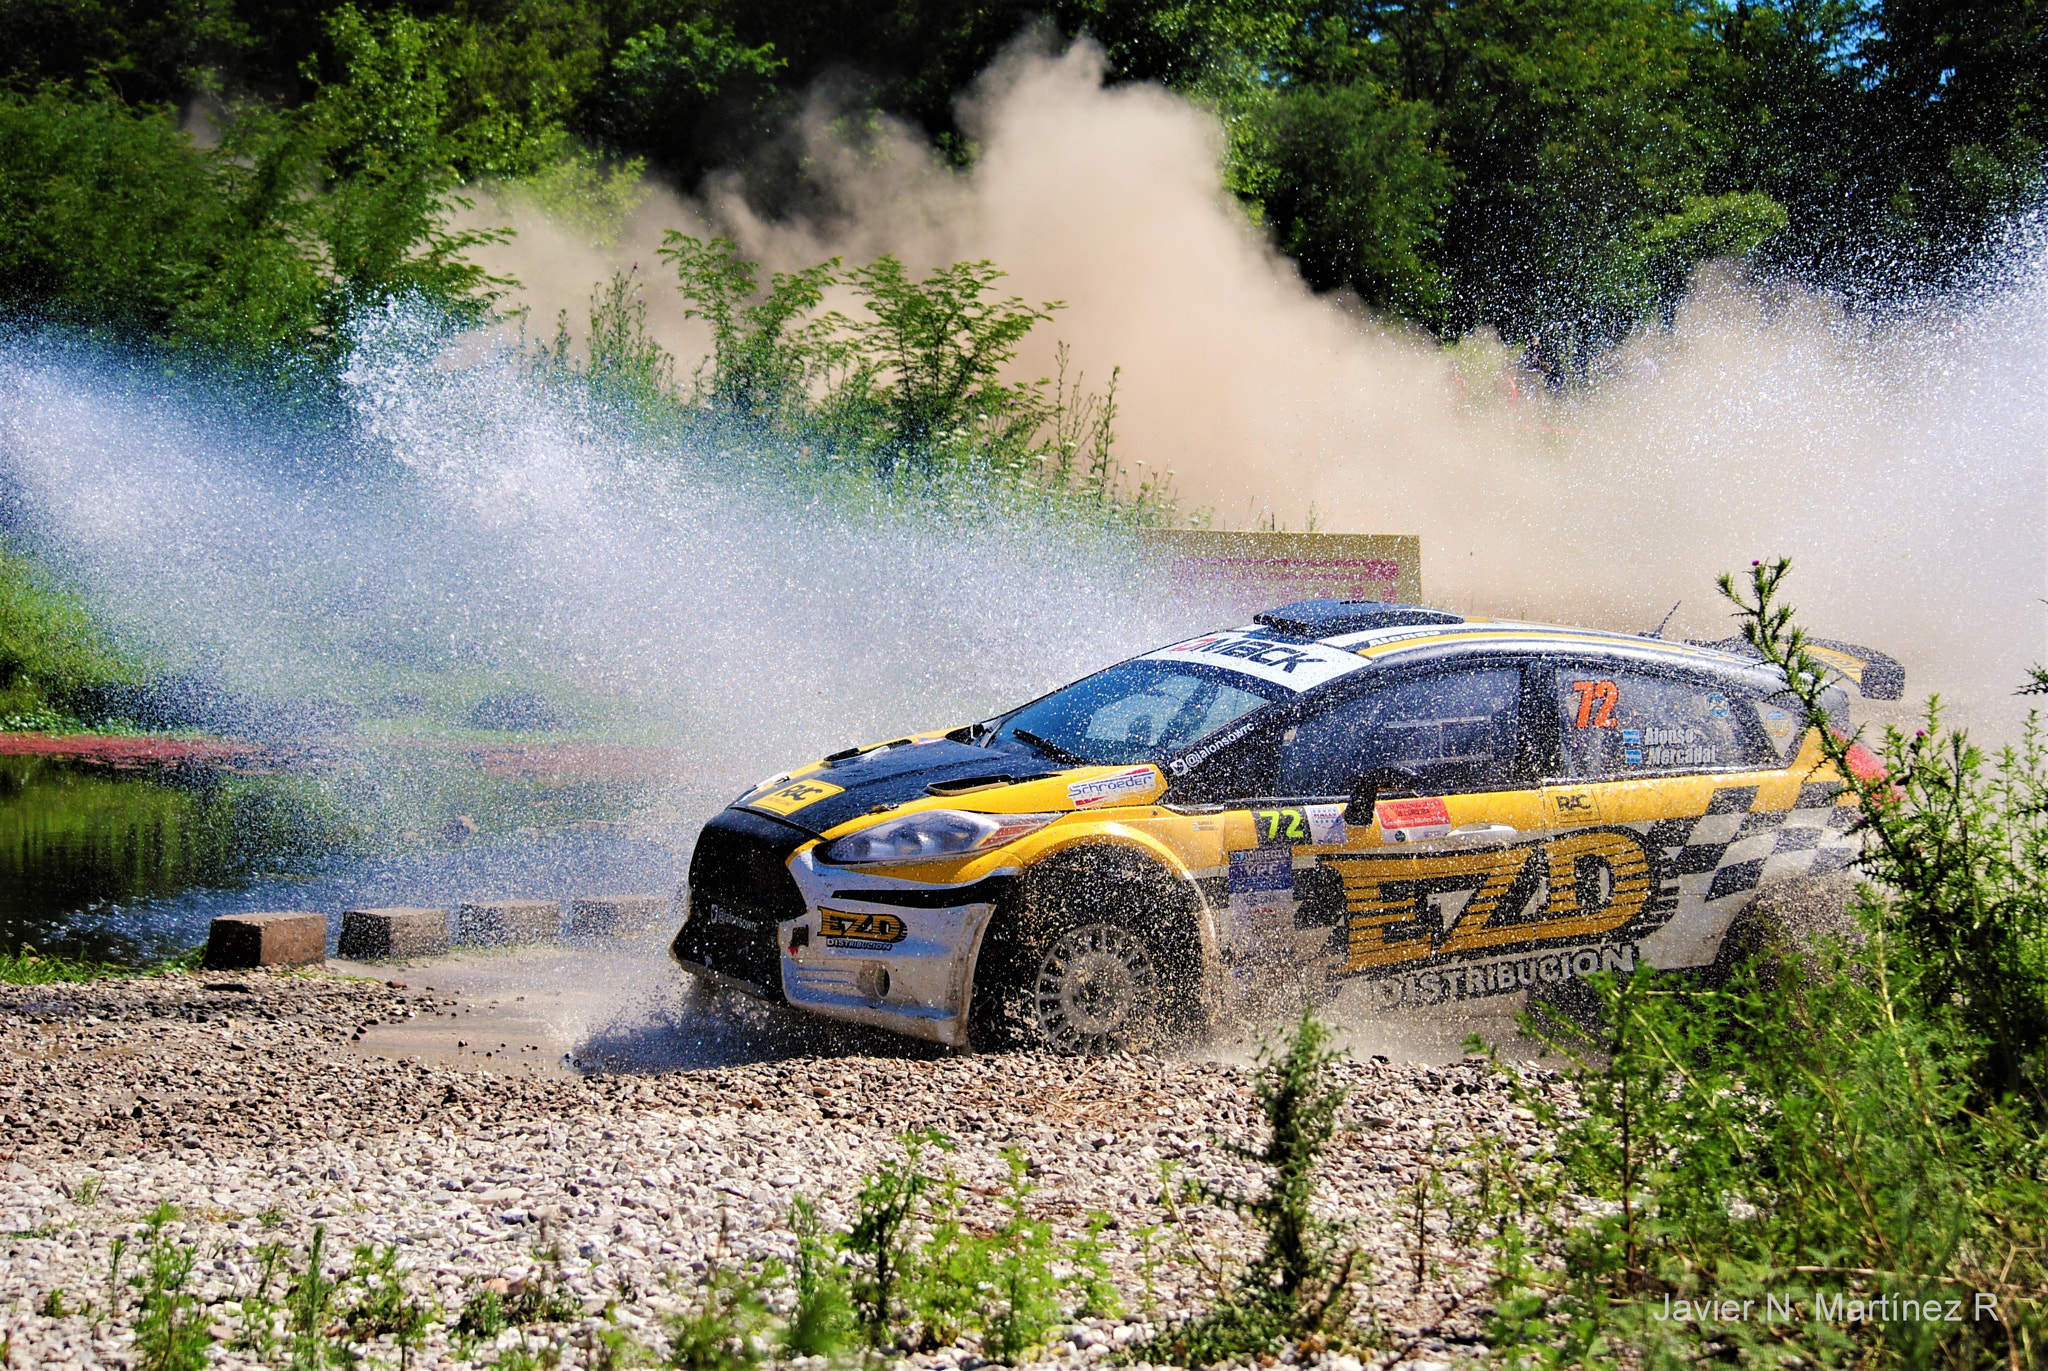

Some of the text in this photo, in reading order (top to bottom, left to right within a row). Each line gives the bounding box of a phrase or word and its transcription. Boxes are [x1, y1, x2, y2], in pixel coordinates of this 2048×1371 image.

[1368, 631, 1440, 648] Alonso
[1573, 680, 1619, 728] 72
[1644, 726, 1695, 746] Alonso
[1067, 771, 1155, 798] Schroeder
[1259, 808, 1304, 839] 72
[827, 938, 892, 950] DISTRIBUCION
